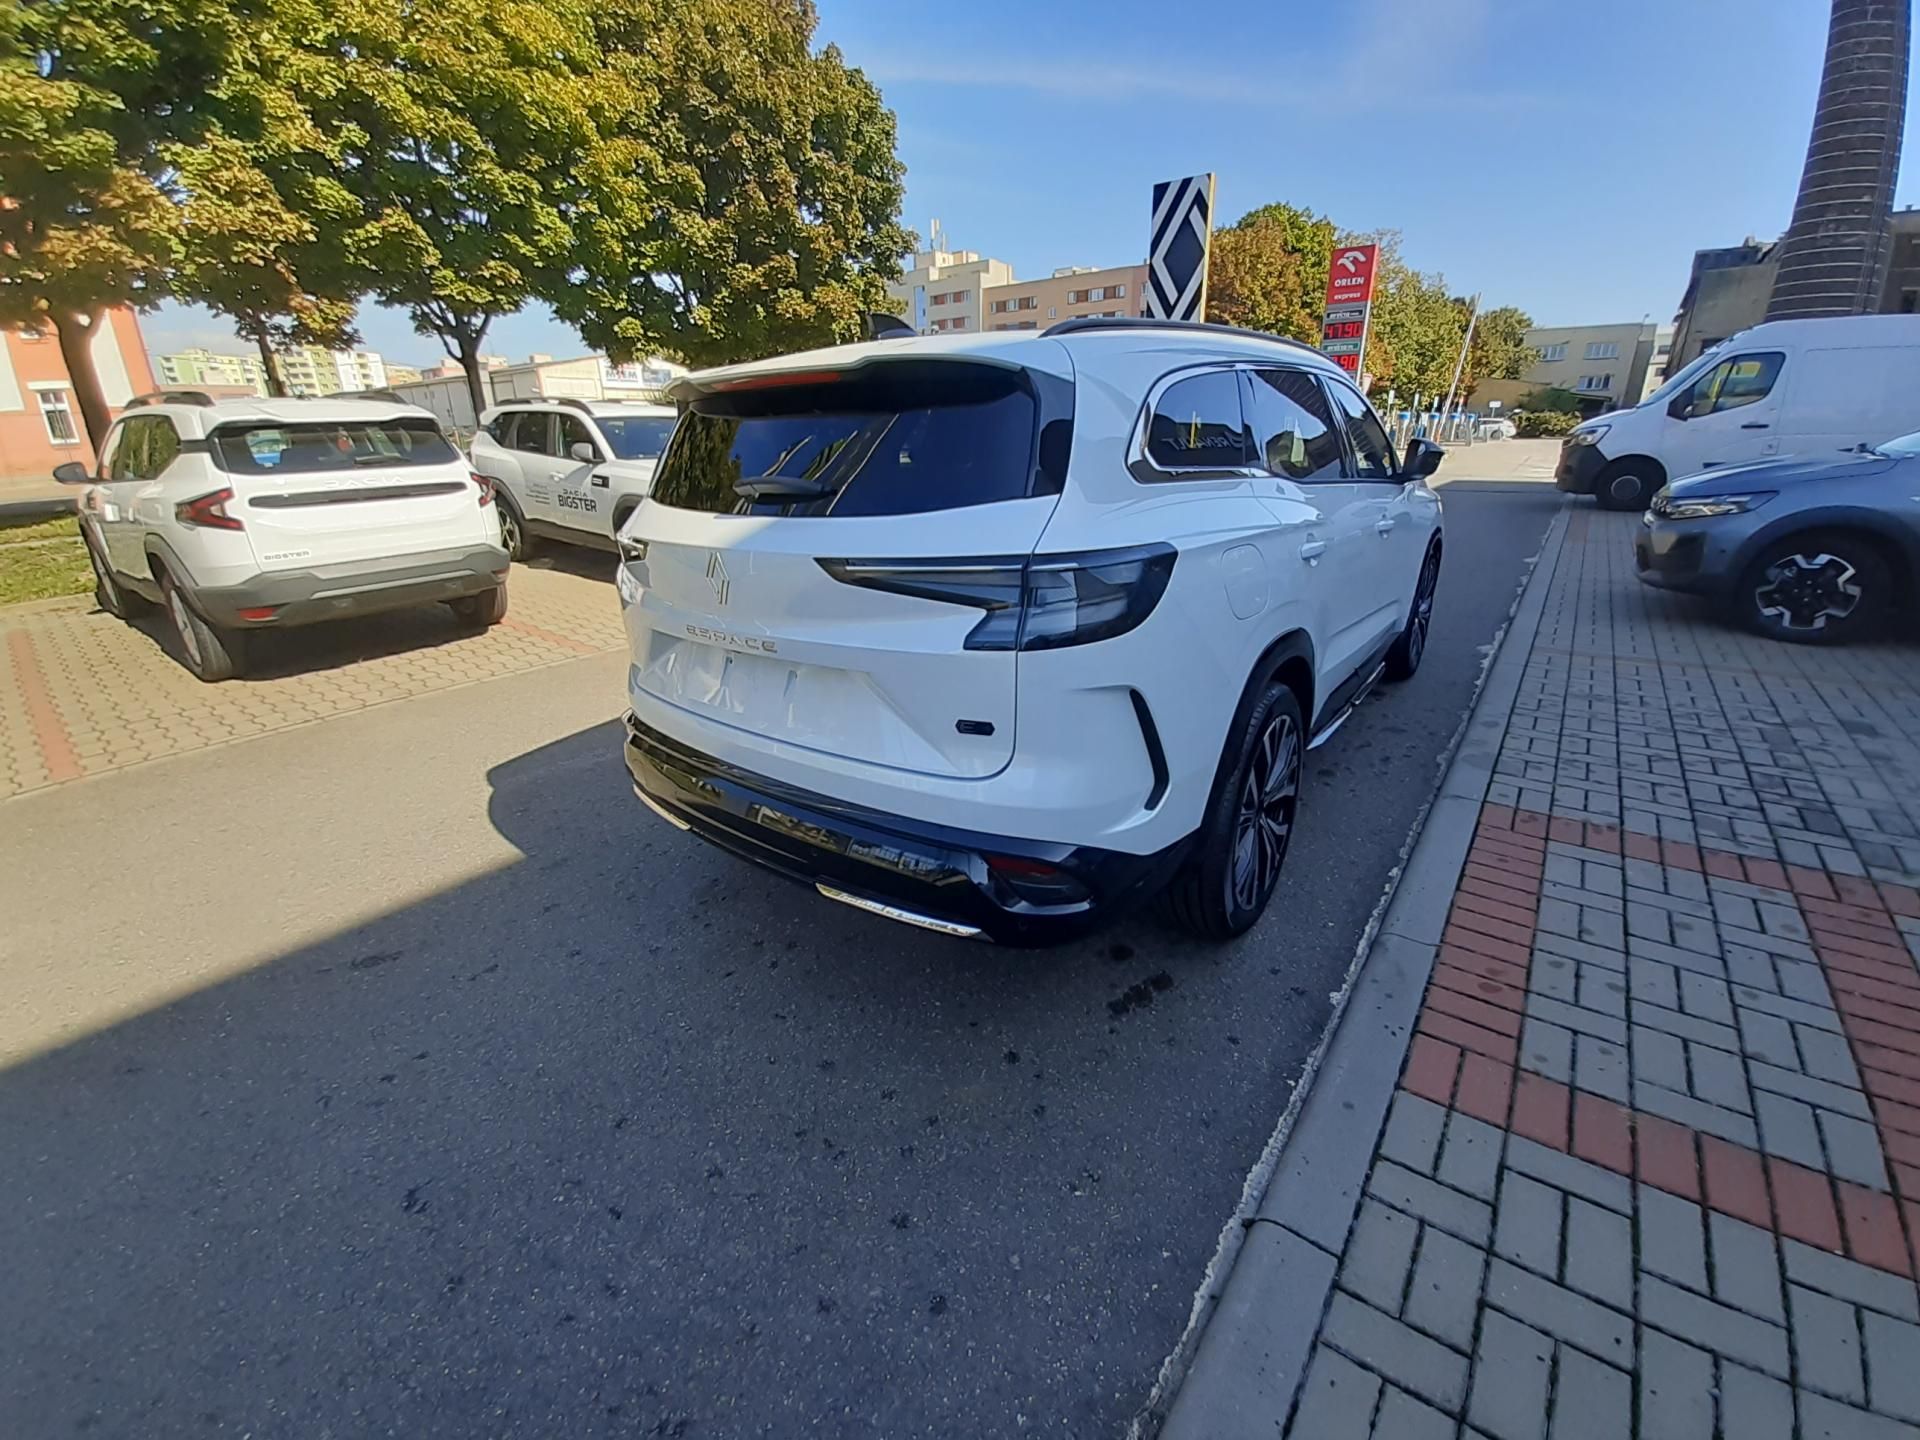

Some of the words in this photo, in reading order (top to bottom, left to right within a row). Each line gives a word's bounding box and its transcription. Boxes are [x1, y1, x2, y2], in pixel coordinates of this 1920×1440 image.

[1334, 277, 1364, 287] ORLEN
[1334, 292, 1361, 301] express
[324, 476, 404, 488] DACIA
[563, 488, 588, 497] DACIA
[558, 494, 597, 512] BIGSTER
[263, 550, 310, 560] BIGSTER
[686, 624, 778, 654] ESPACE
